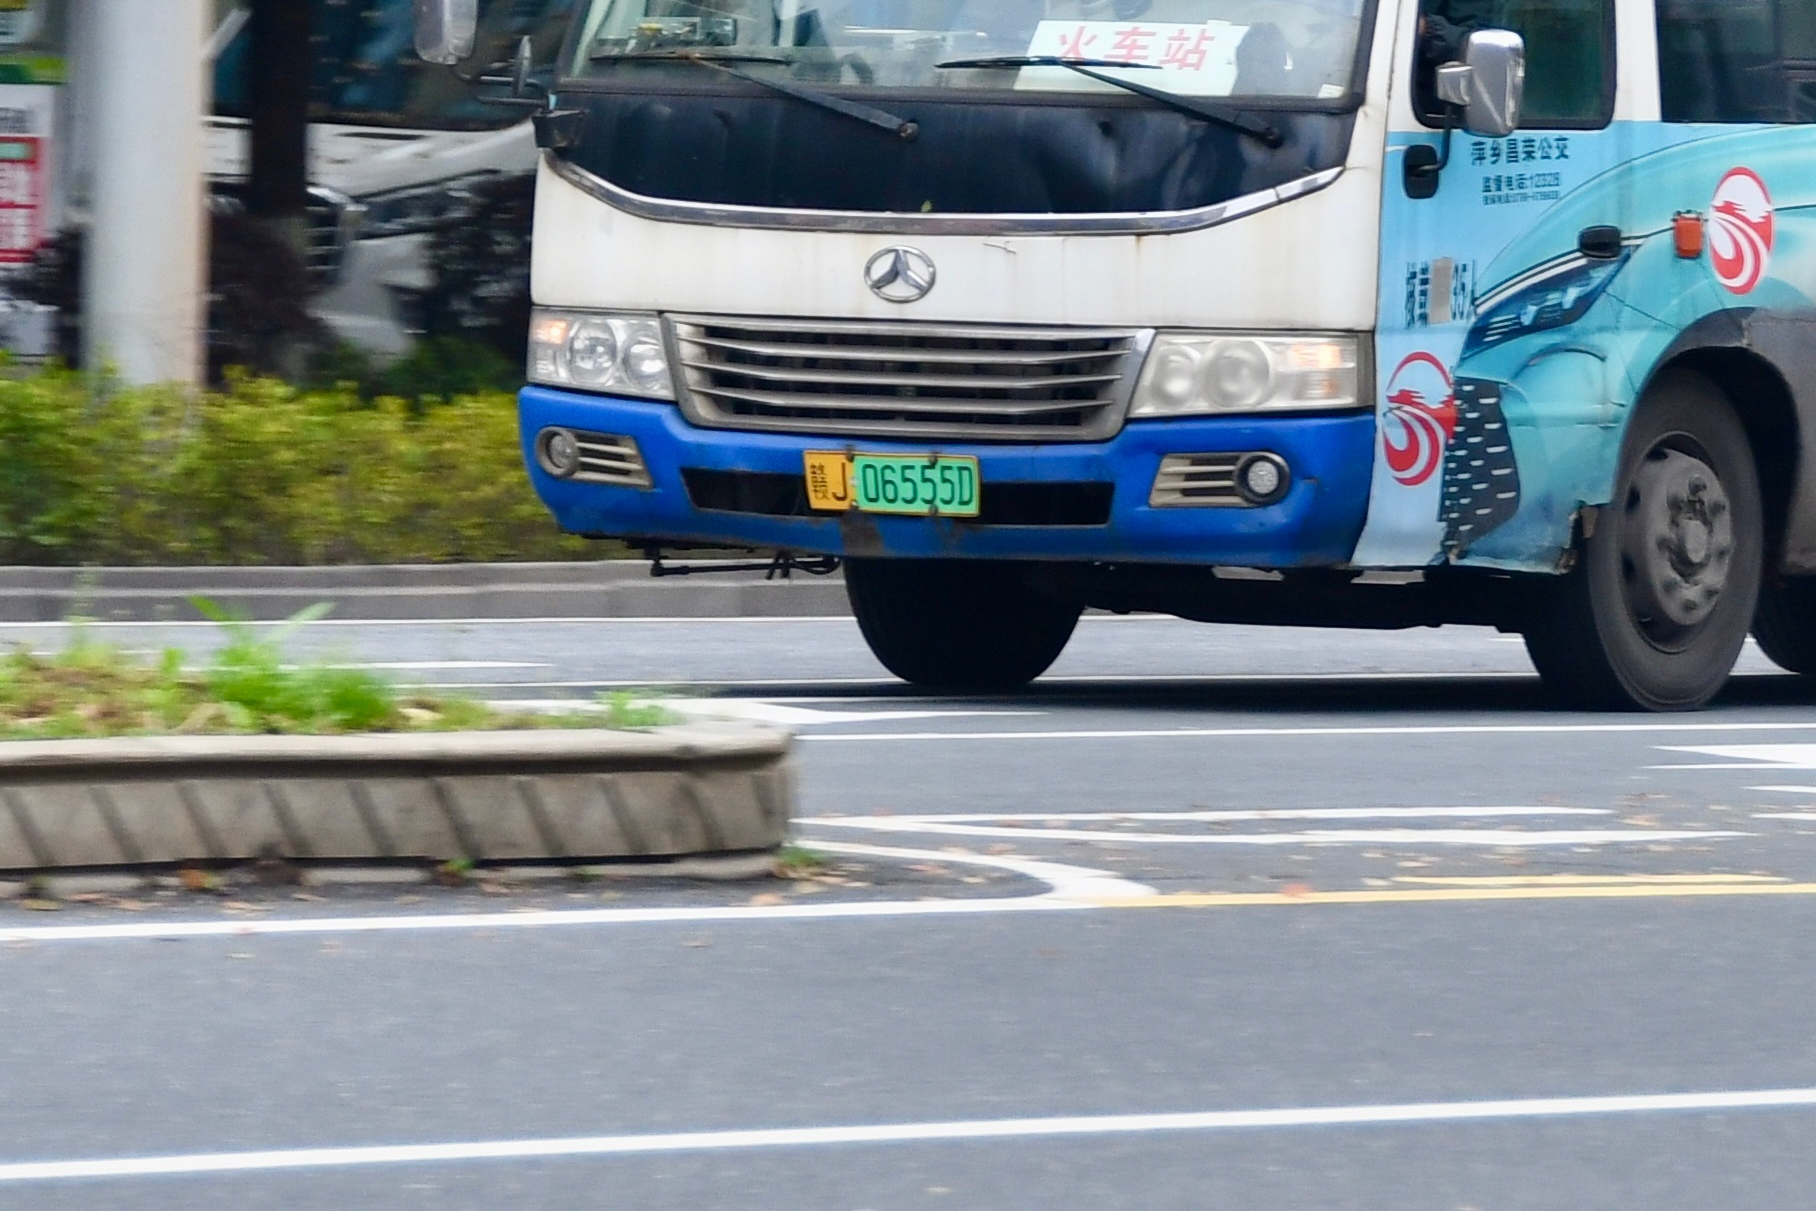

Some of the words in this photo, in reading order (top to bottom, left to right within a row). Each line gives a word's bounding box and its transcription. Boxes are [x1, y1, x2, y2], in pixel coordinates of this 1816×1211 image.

[1058, 25, 1216, 71] 火车站
[1470, 135, 1570, 165] 萍乡昌荣公交
